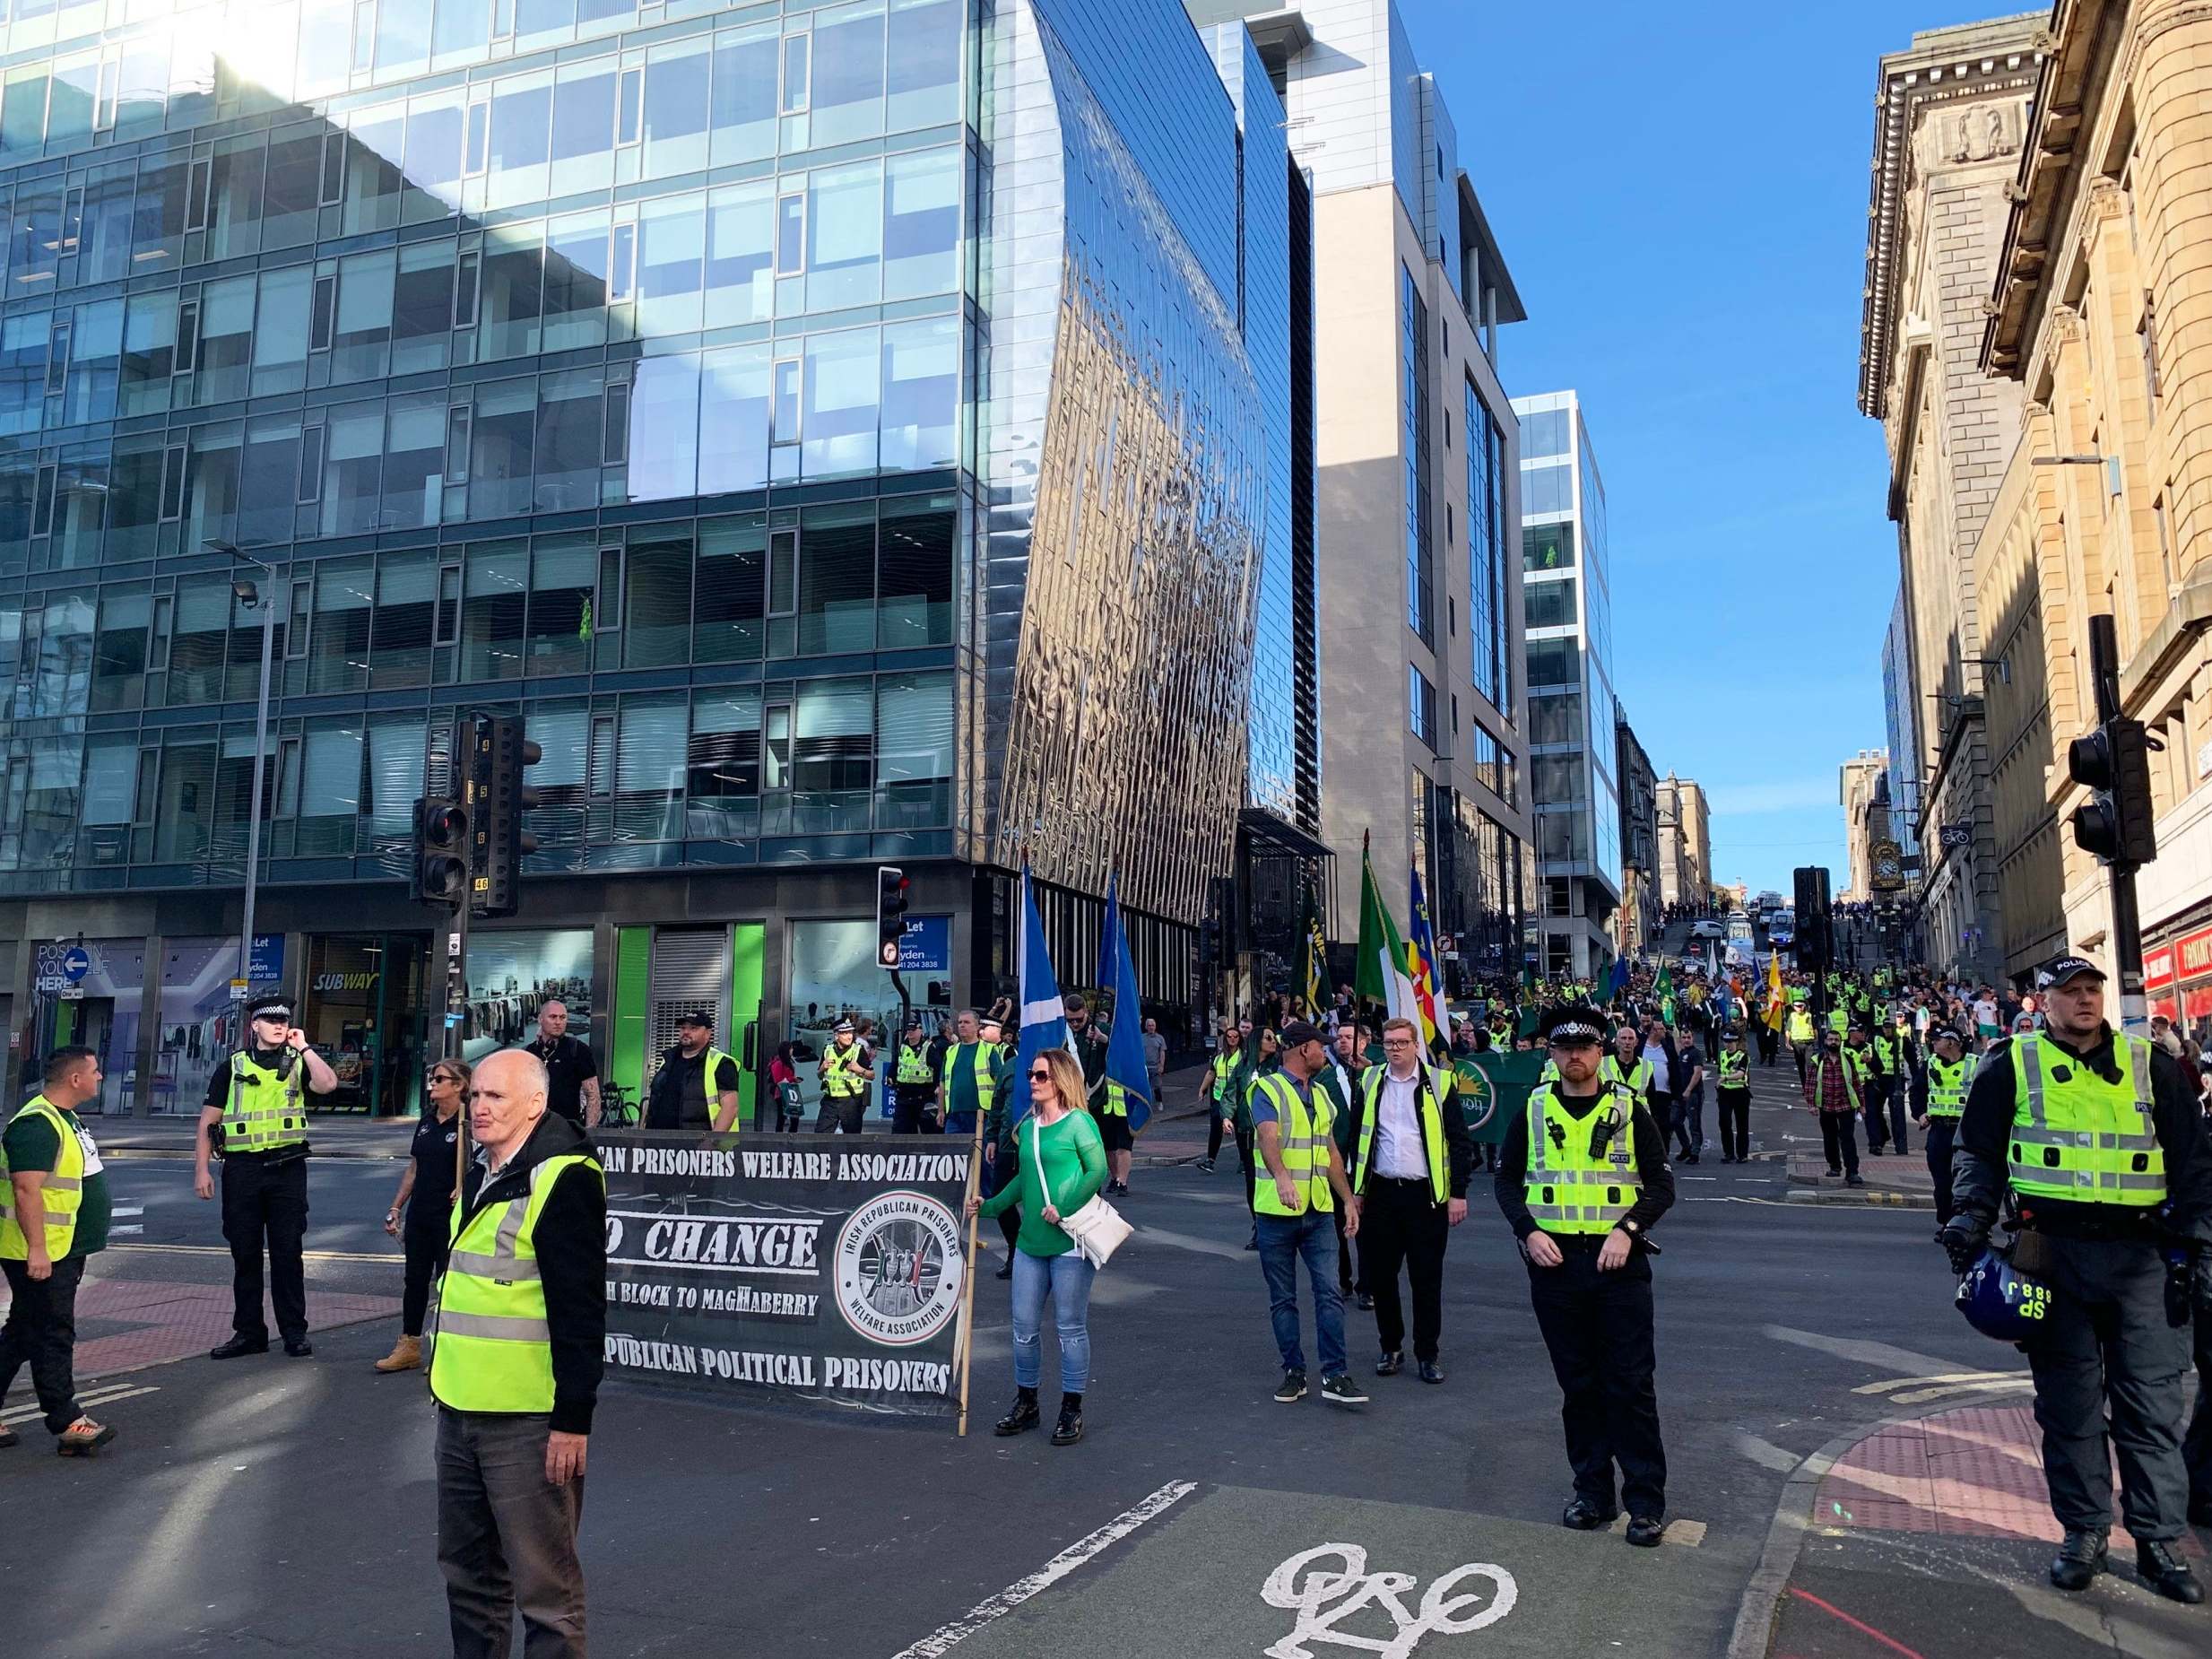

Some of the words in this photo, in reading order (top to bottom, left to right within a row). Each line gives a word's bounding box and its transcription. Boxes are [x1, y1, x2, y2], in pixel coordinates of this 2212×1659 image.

[906, 921, 924, 932] Let
[255, 937, 269, 948] Let
[899, 950, 925, 961] yden
[37, 960, 109, 976] YOUELF
[249, 963, 268, 971] yden
[921, 960, 938, 968] 3838
[2057, 960, 2091, 970] POLICE
[36, 976, 72, 991] HERE
[314, 972, 379, 991] SUBWAY
[631, 1147, 735, 1177] PRISONERS
[742, 1151, 831, 1180] WELFARE
[837, 1153, 968, 1182] ASSOCIATION
[1610, 1154, 1629, 1163] POLICE
[845, 1227, 863, 1255] IRISH
[861, 1201, 919, 1229] REPUBLICAN
[921, 1206, 959, 1257] PRISONERS
[644, 1220, 819, 1268] CHANGE
[620, 1281, 672, 1307] BLOCK
[676, 1286, 698, 1308] TO
[701, 1286, 820, 1317] MAGHABERRY
[850, 1298, 884, 1333] WELFARE
[887, 1302, 945, 1335] ASSOCIATION
[604, 1335, 698, 1375] PUBLICAN
[700, 1347, 817, 1386] POLITICAL
[824, 1356, 950, 1395] PRISONERS
